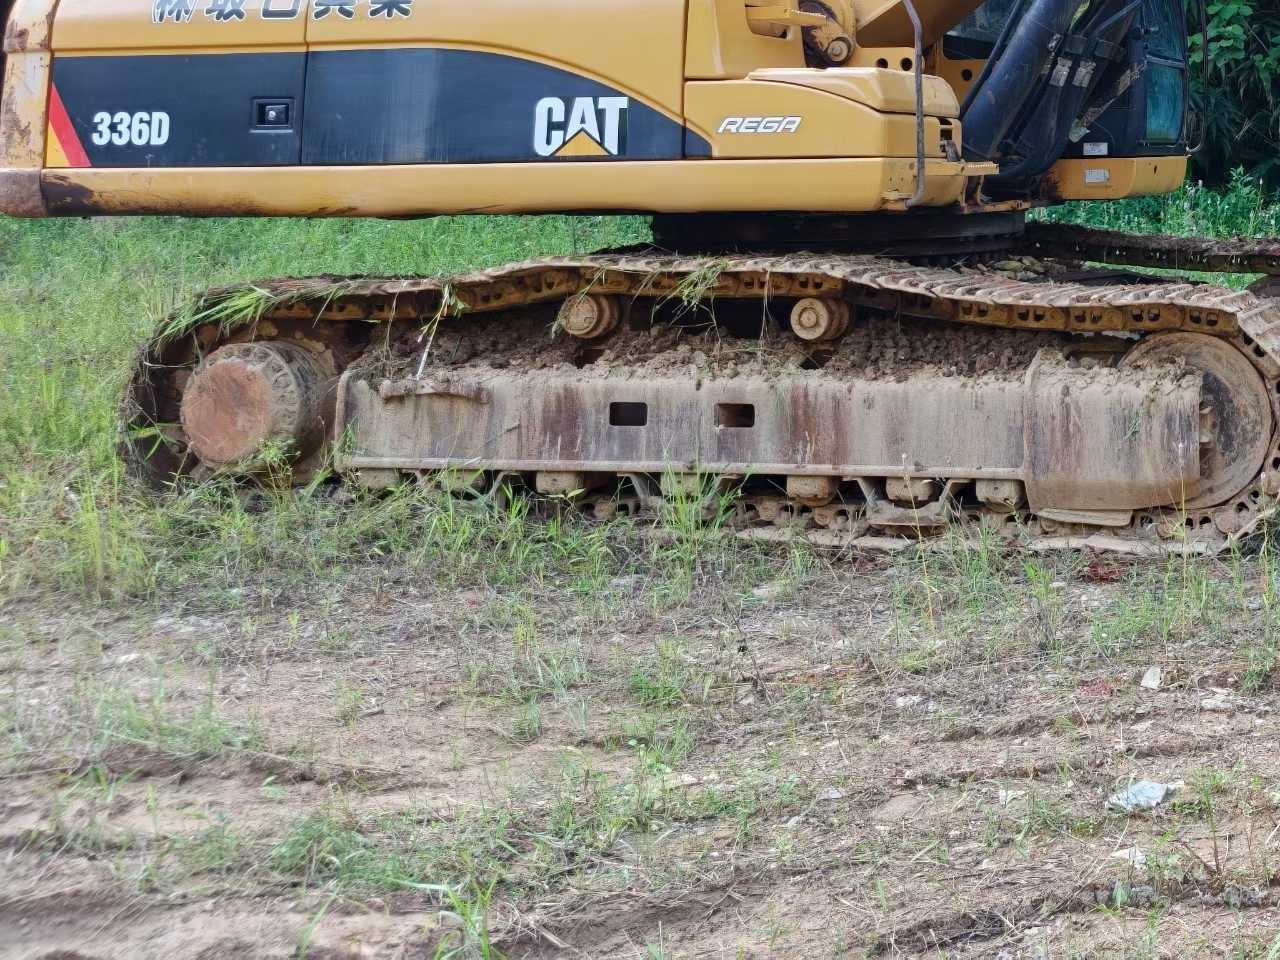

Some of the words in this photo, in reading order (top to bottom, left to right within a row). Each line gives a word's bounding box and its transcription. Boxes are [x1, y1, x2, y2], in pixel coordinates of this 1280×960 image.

[92, 111, 170, 146] 336D
[533, 96, 629, 157] CAT
[717, 116, 802, 133] REGA
